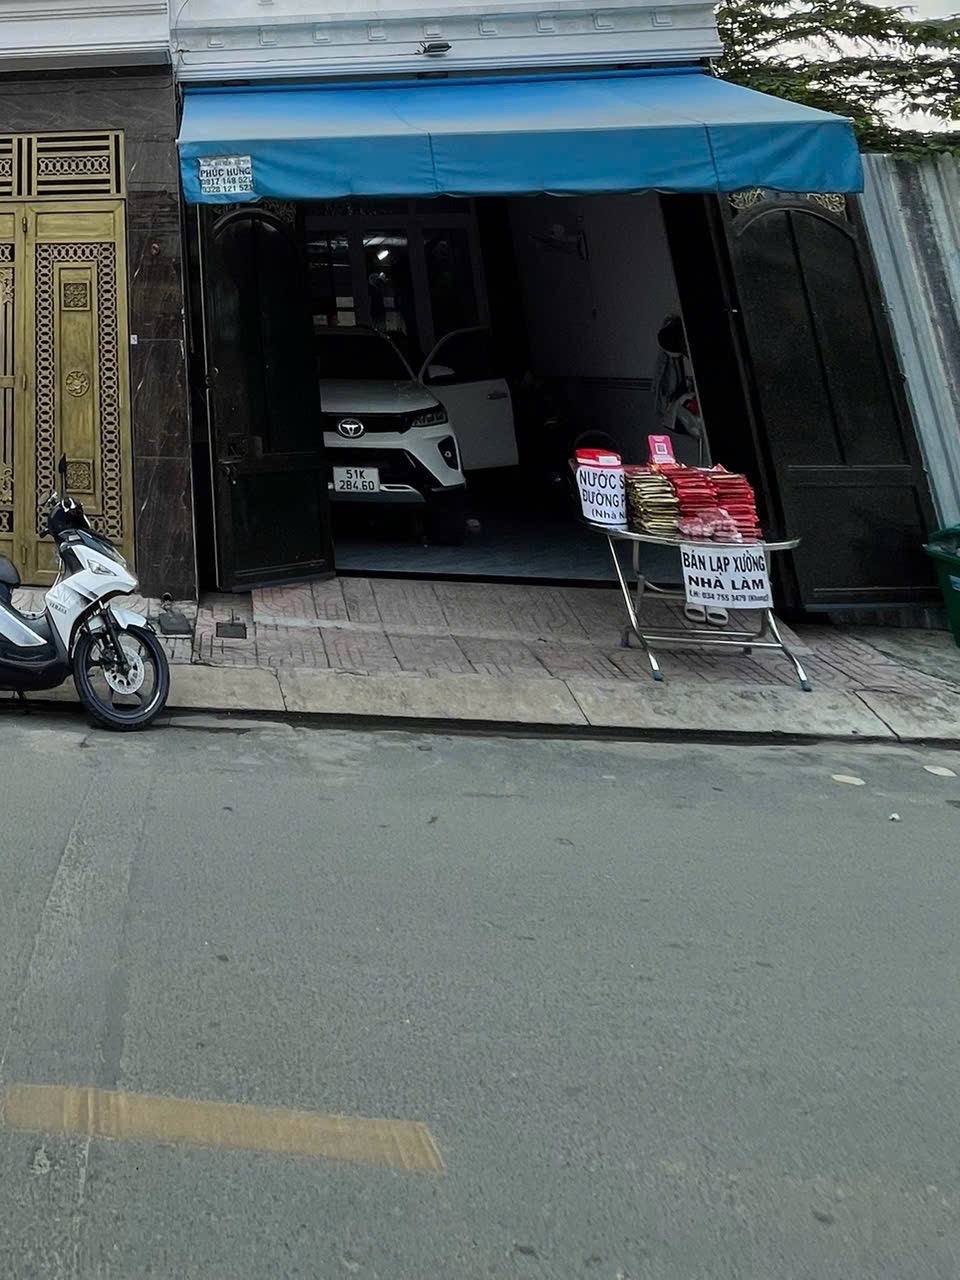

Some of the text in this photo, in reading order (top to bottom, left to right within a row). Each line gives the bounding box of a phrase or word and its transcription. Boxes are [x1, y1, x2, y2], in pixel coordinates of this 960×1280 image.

[200, 167, 224, 177] PHÚC
[346, 469, 366, 480] 51K
[579, 470, 617, 490] NƯỚC
[582, 488, 620, 508] ĐƯỜNG
[682, 549, 707, 571] BÁN
[709, 555, 730, 576] LẠP
[688, 575, 765, 591] NHÀ LÀM
